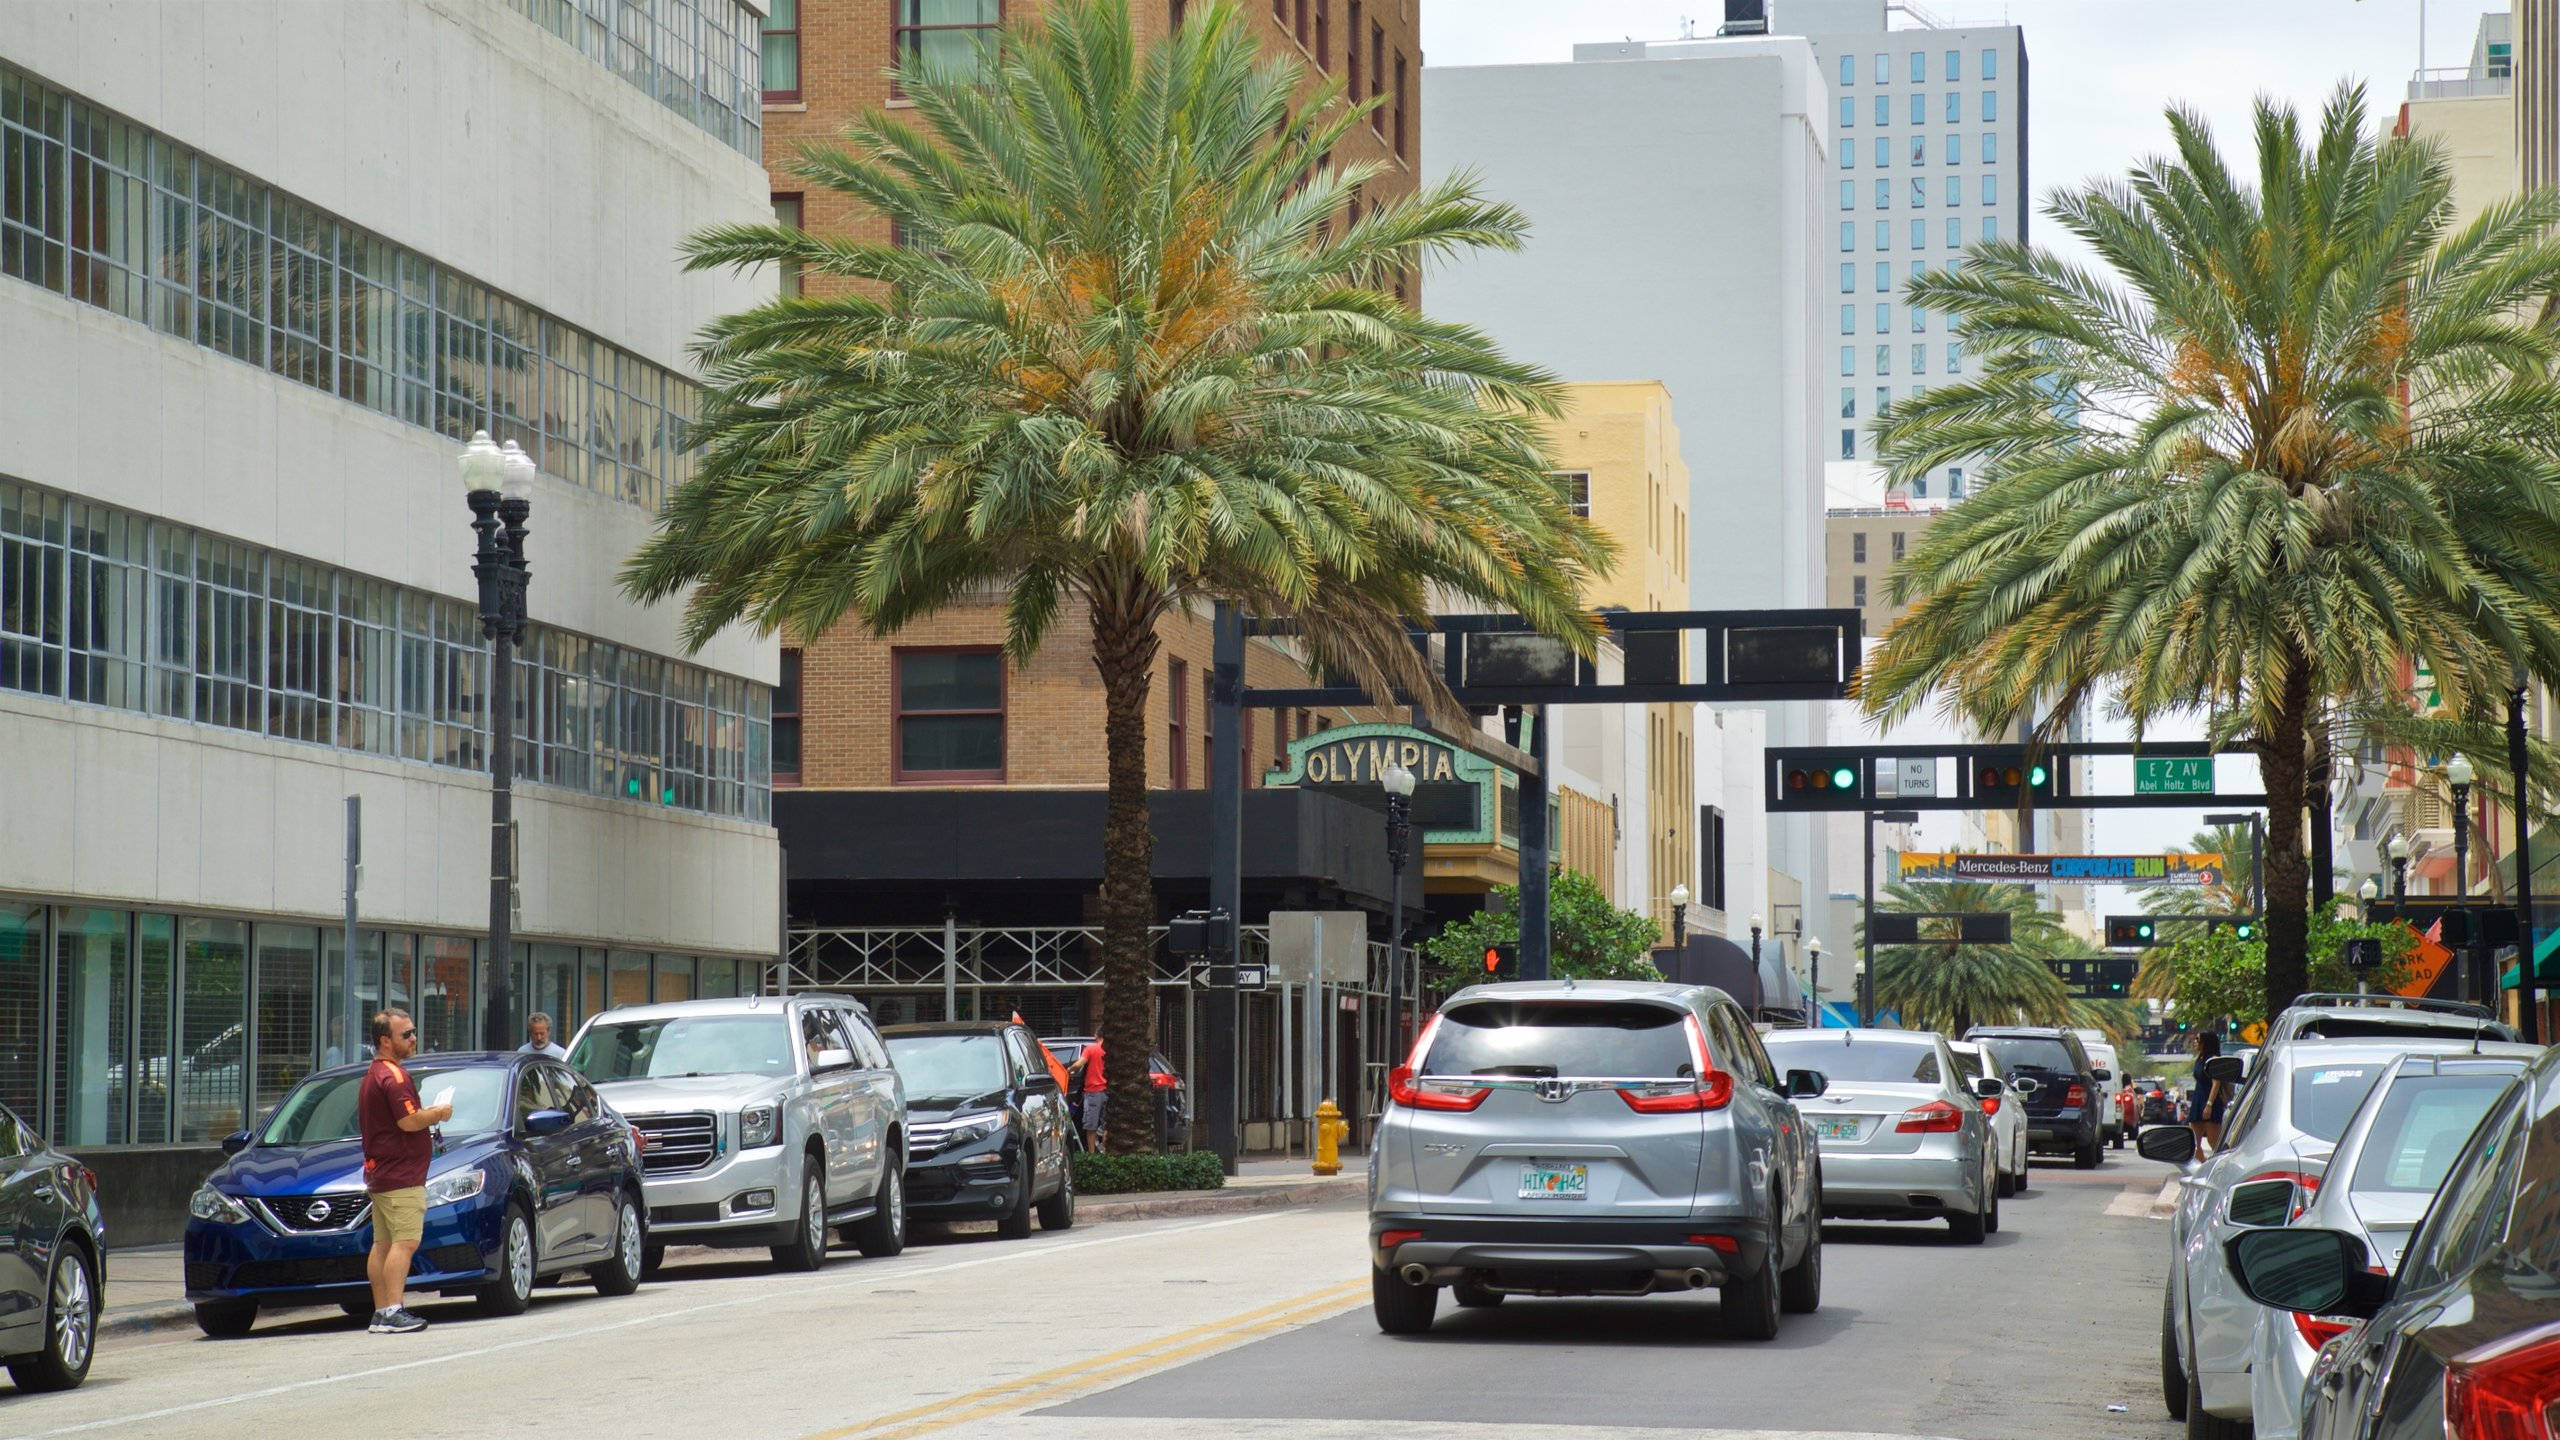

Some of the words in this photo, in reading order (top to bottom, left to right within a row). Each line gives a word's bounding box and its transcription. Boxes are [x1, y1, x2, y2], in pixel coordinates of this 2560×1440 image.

[1307, 740, 1453, 783] OLYMPIA
[1910, 765, 1923, 774] NO
[2149, 762, 2156, 777] E
[2165, 761, 2173, 778] 2
[2183, 762, 2198, 776] AV
[1904, 780, 1930, 789] TURNS
[2140, 780, 2158, 791] Abel
[2164, 780, 2185, 790] Holtz
[2192, 779, 2210, 790] Blvd
[1959, 859, 2049, 874] Mercedes-Benz
